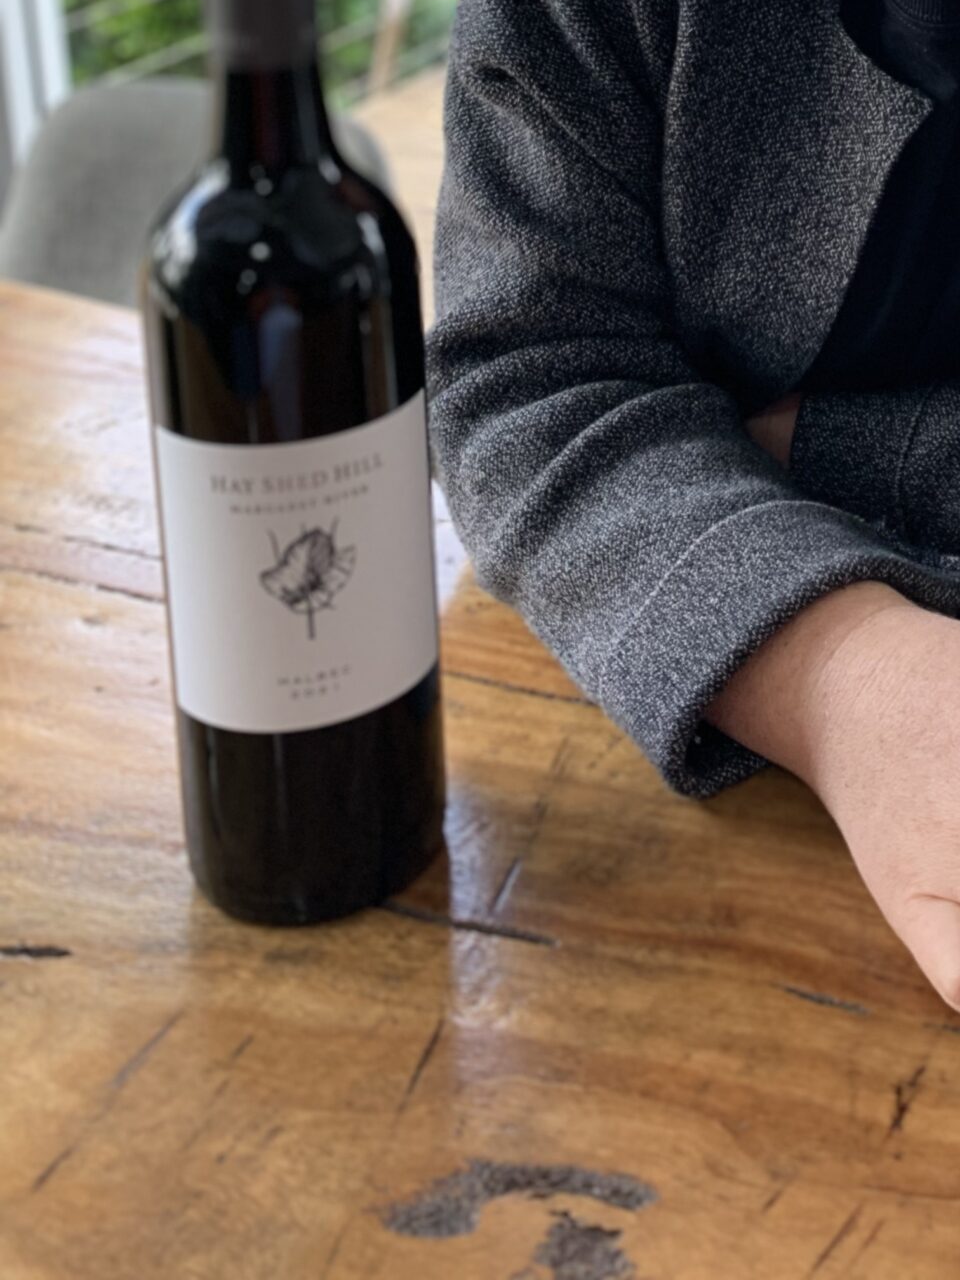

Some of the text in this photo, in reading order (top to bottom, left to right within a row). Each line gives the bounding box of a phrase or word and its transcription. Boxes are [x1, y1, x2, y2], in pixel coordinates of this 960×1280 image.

[209, 451, 383, 496] HAY SHED HILL
